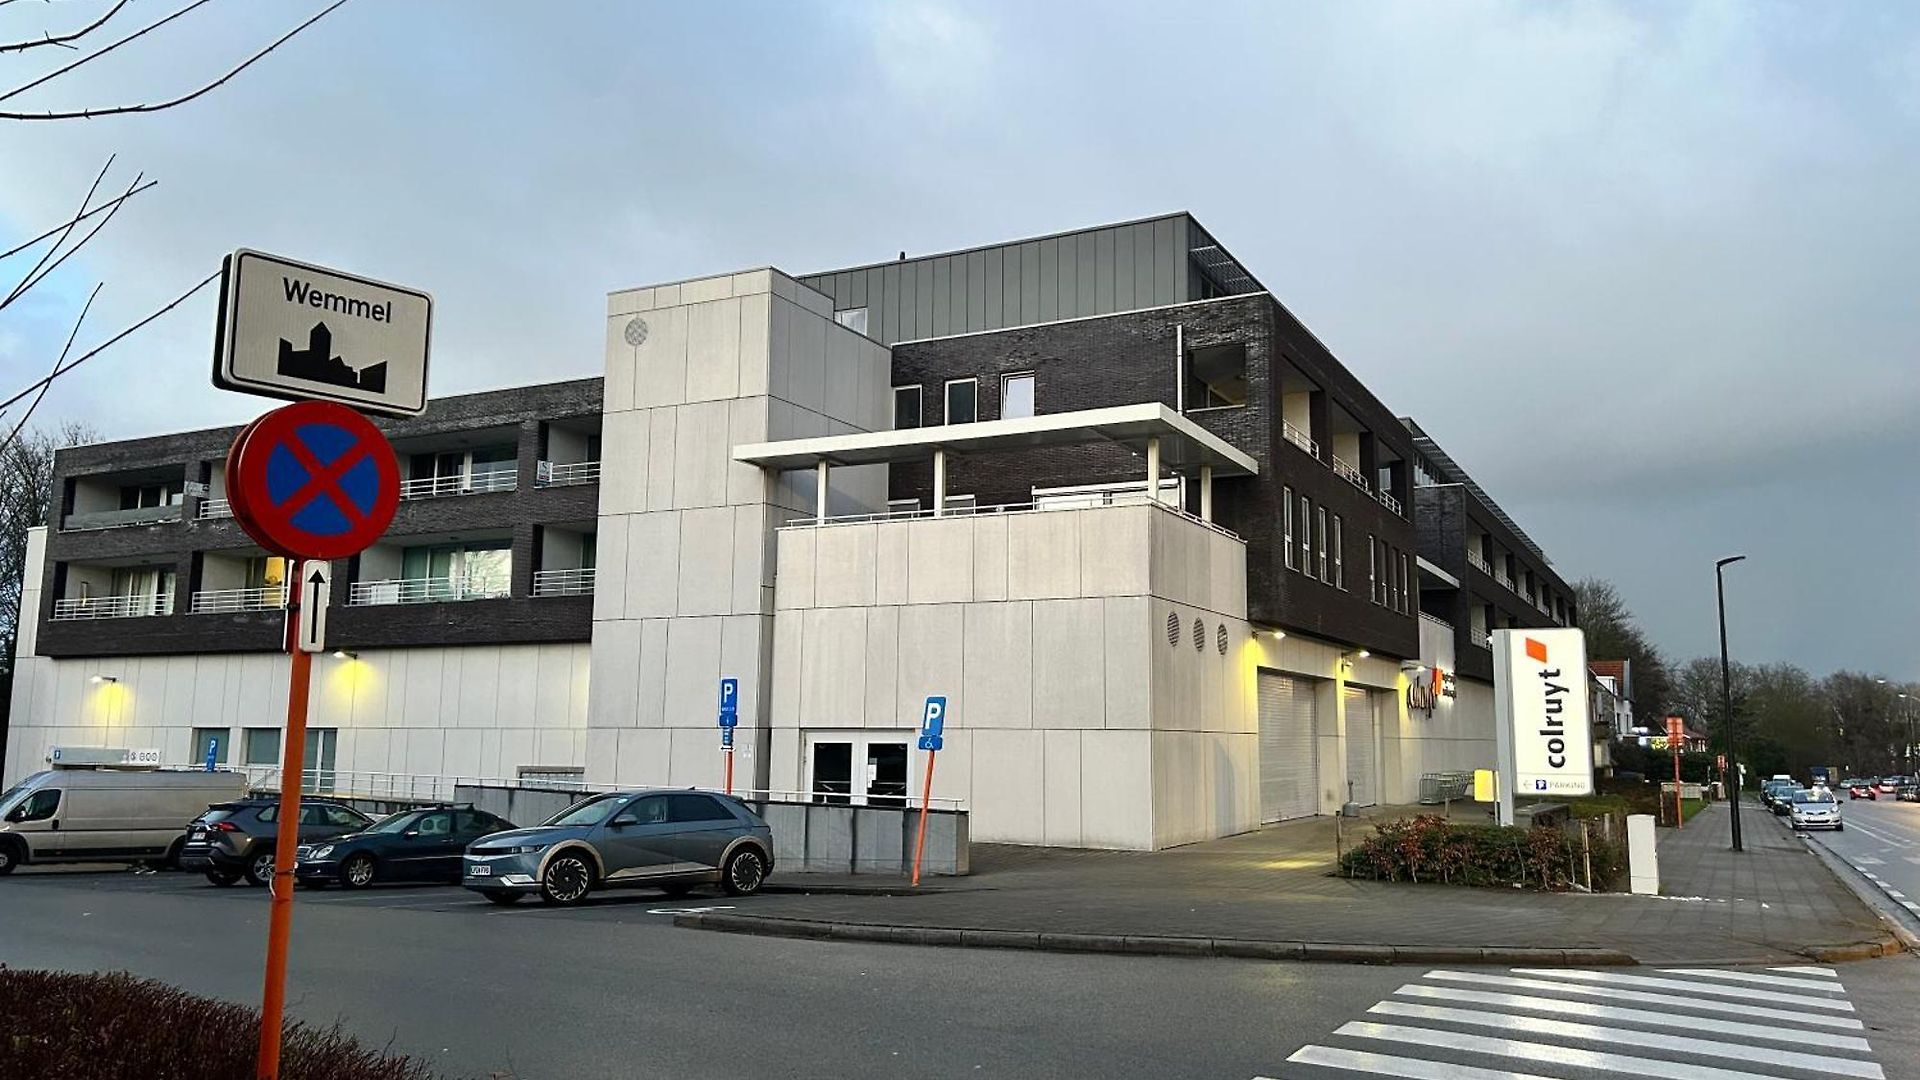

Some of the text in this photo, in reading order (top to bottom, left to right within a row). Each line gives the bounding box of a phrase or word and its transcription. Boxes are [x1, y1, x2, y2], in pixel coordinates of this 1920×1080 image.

[283, 277, 391, 323] Wemmel
[723, 683, 734, 704] P
[925, 702, 942, 730] P
[1538, 668, 1570, 769] colruyt
